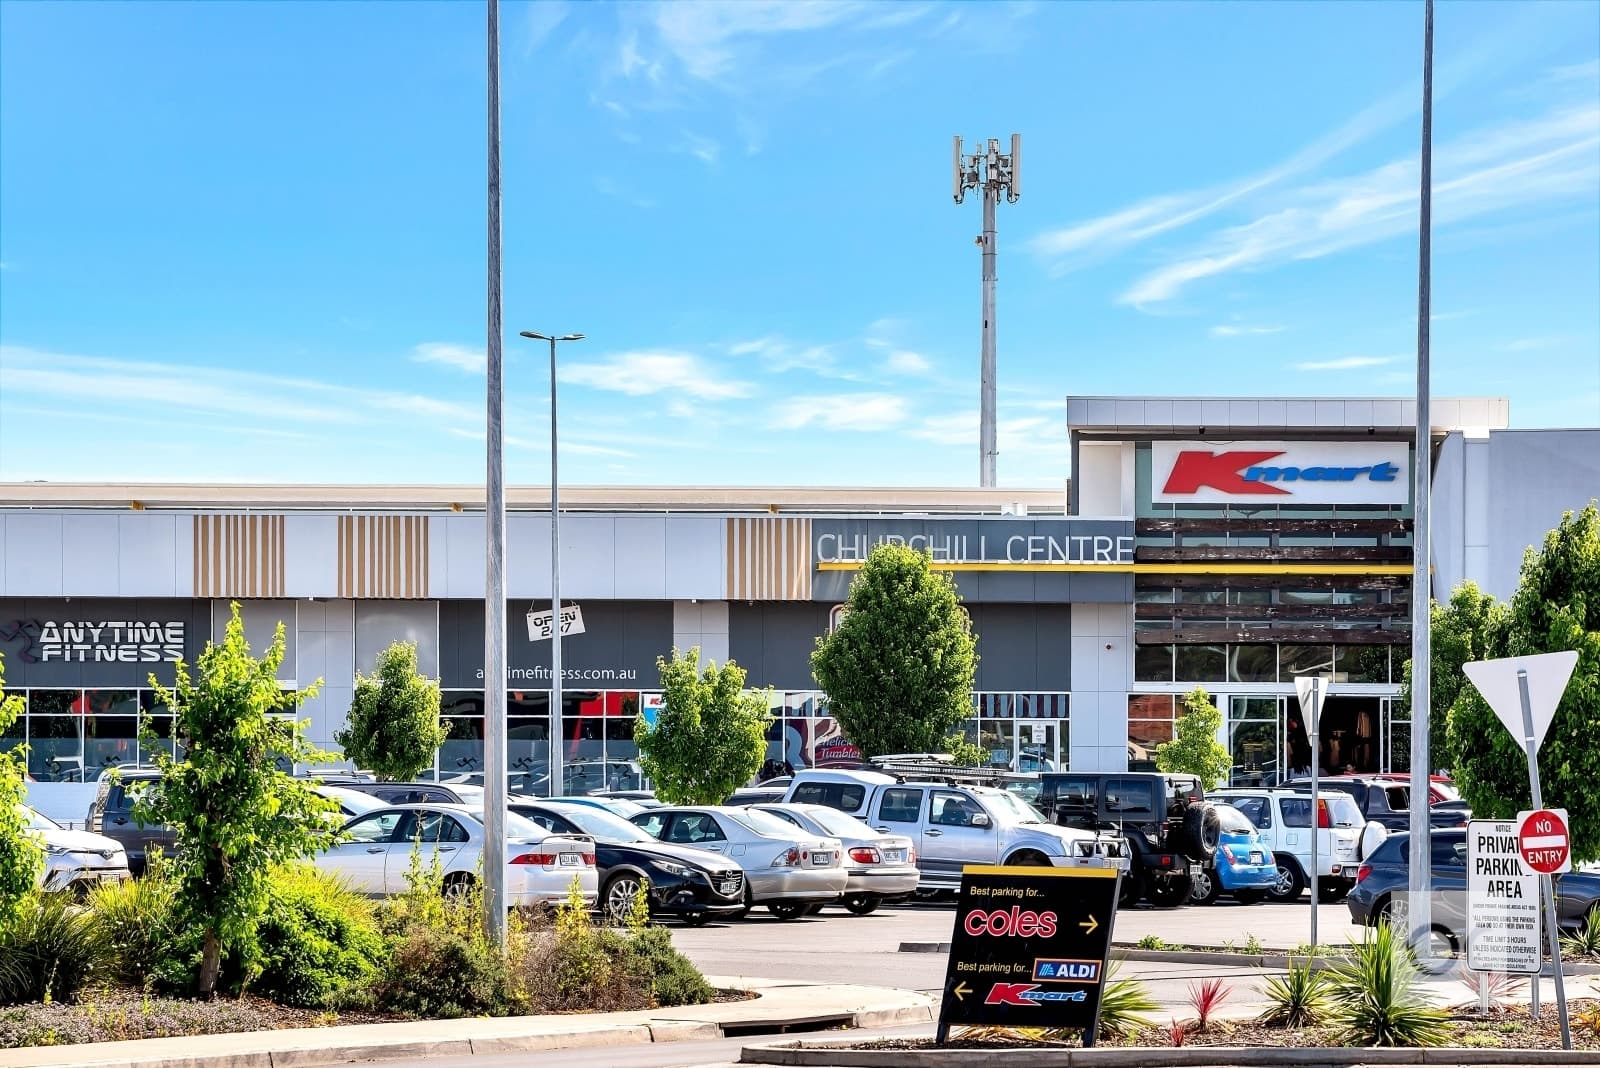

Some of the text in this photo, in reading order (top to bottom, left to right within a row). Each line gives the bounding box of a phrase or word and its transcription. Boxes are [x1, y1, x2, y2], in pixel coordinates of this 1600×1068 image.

[1162, 450, 1400, 495] Kmart
[1006, 534, 1135, 564] CENTRE
[39, 621, 185, 643] ANYTIME
[42, 644, 185, 662] FITNESS
[476, 665, 637, 681] aimefitess.com.au
[1495, 824, 1512, 833] NOTICE
[1535, 820, 1552, 834] NO
[1477, 836, 1520, 854] PRIVAT
[1528, 849, 1563, 864] ENTRY
[1476, 857, 1533, 877] PARKIN
[970, 886, 1045, 899] Best parking for...
[1487, 879, 1523, 899] AREA
[964, 905, 1058, 938] coles
[957, 961, 1033, 974] Best parking for...
[1056, 963, 1096, 979] ALDI
[983, 982, 1088, 1007] Kmart
